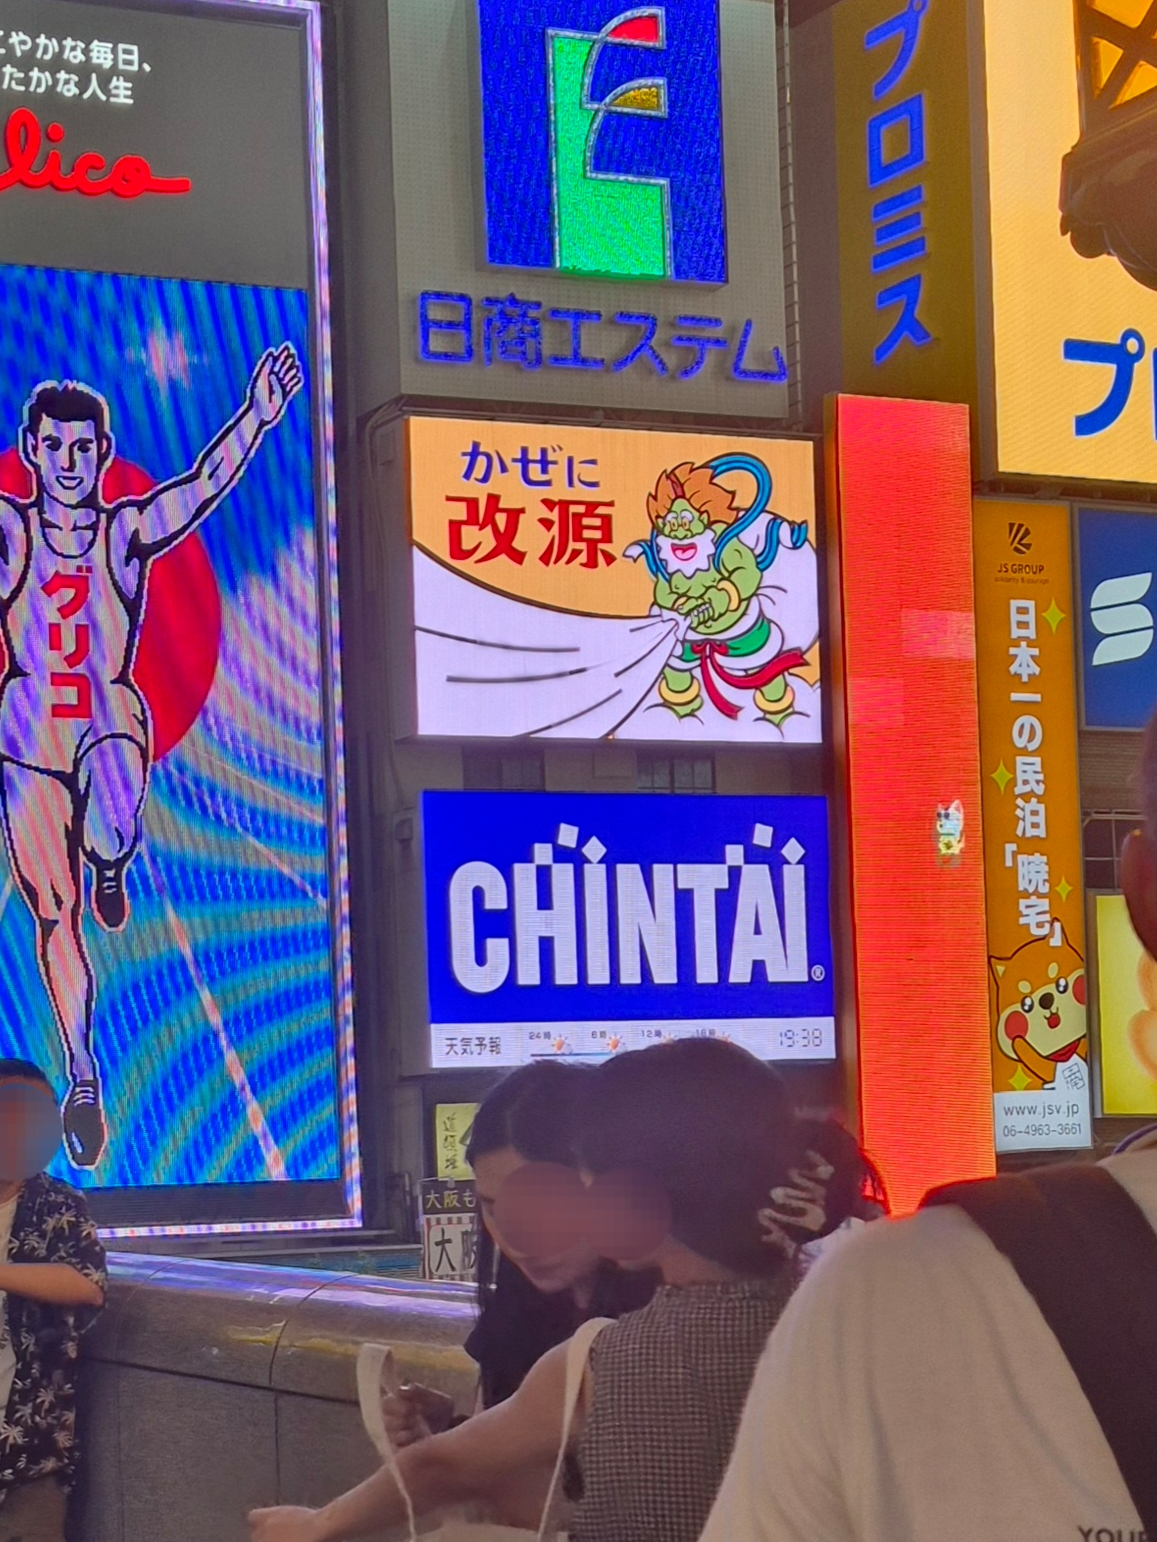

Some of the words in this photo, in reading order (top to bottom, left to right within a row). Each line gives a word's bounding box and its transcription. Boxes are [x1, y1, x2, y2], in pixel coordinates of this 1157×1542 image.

[864, 0, 934, 366] プロミス
[419, 290, 787, 382] 日商エステム
[1062, 328, 1157, 440] プ
[461, 441, 601, 488] かぜに
[446, 493, 618, 569] 改源
[997, 563, 1010, 573] JS
[1011, 563, 1045, 575] GROUP
[41, 564, 92, 720] グリコ
[449, 823, 809, 993] CHINTAI
[445, 1037, 501, 1056] 天気予報
[780, 1028, 822, 1047] 19:38
[1003, 1101, 1079, 1118] www.jsv.jp
[1003, 1123, 1081, 1137] 06-4963-3661
